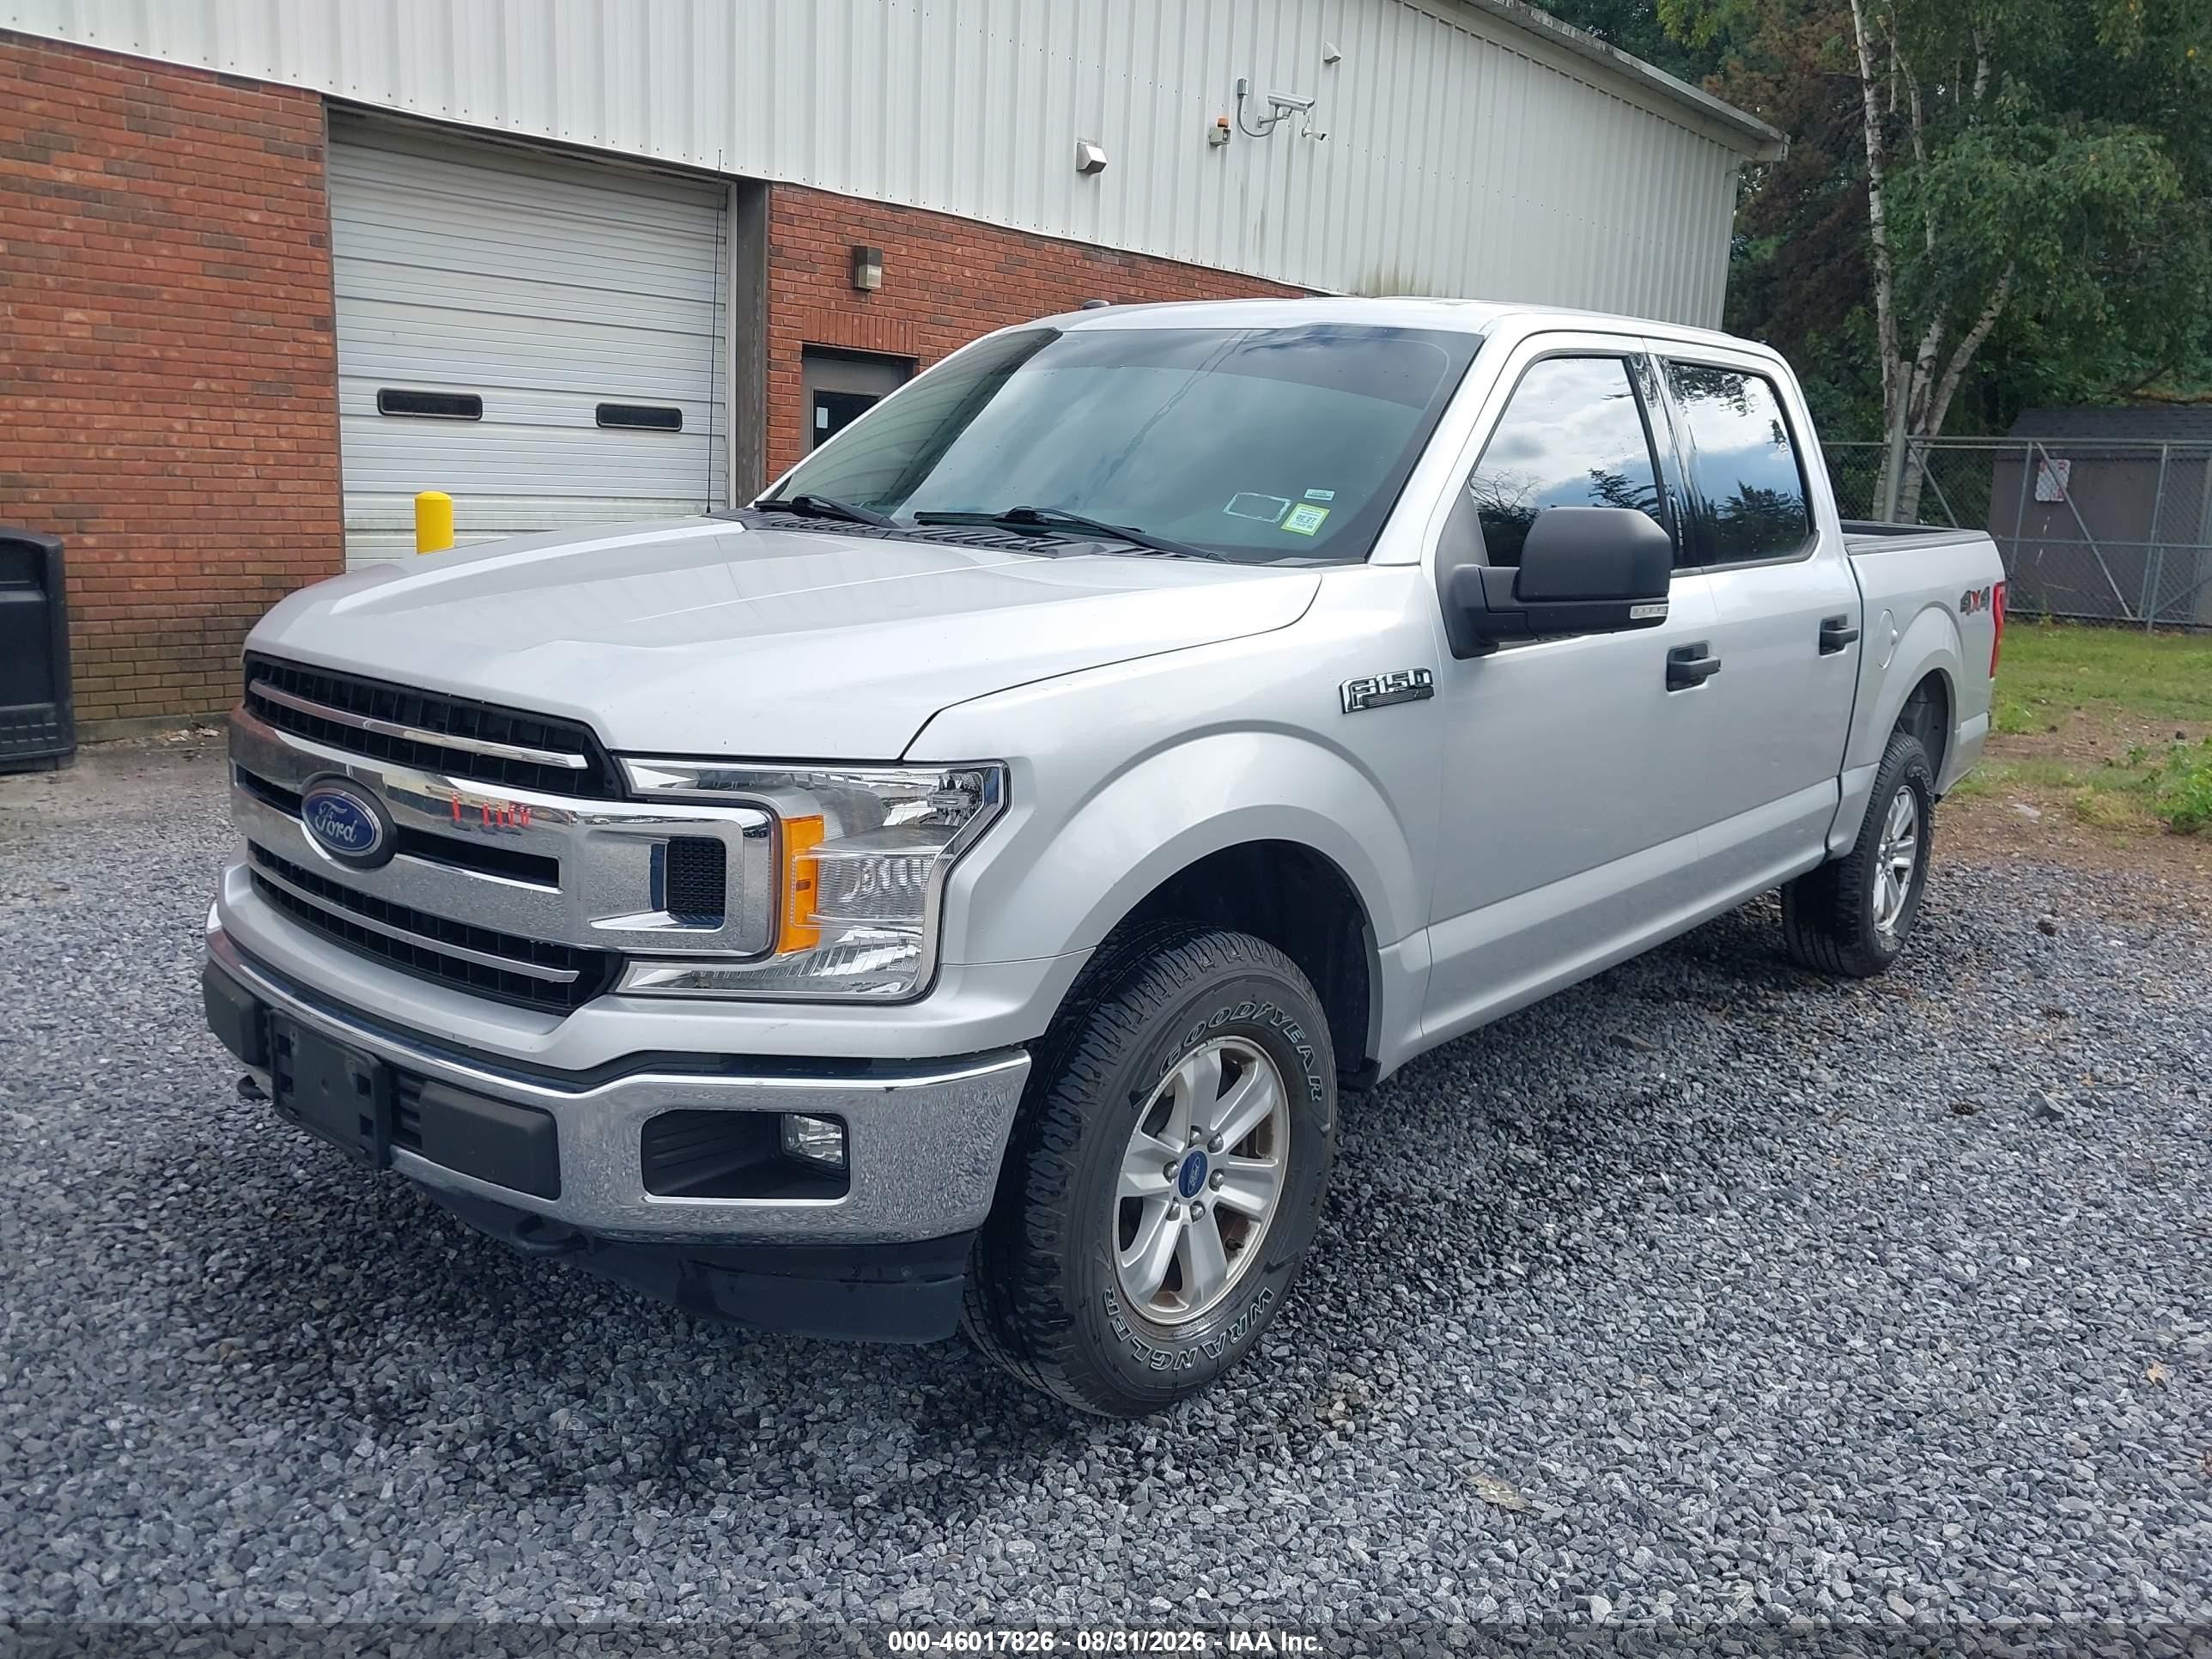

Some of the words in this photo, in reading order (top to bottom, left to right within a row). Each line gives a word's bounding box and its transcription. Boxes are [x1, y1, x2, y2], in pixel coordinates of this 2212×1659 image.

[314, 800, 358, 843] Ford
[1159, 1000, 1324, 1103] GOODYEAR
[1103, 1286, 1275, 1370] WRANGLER
